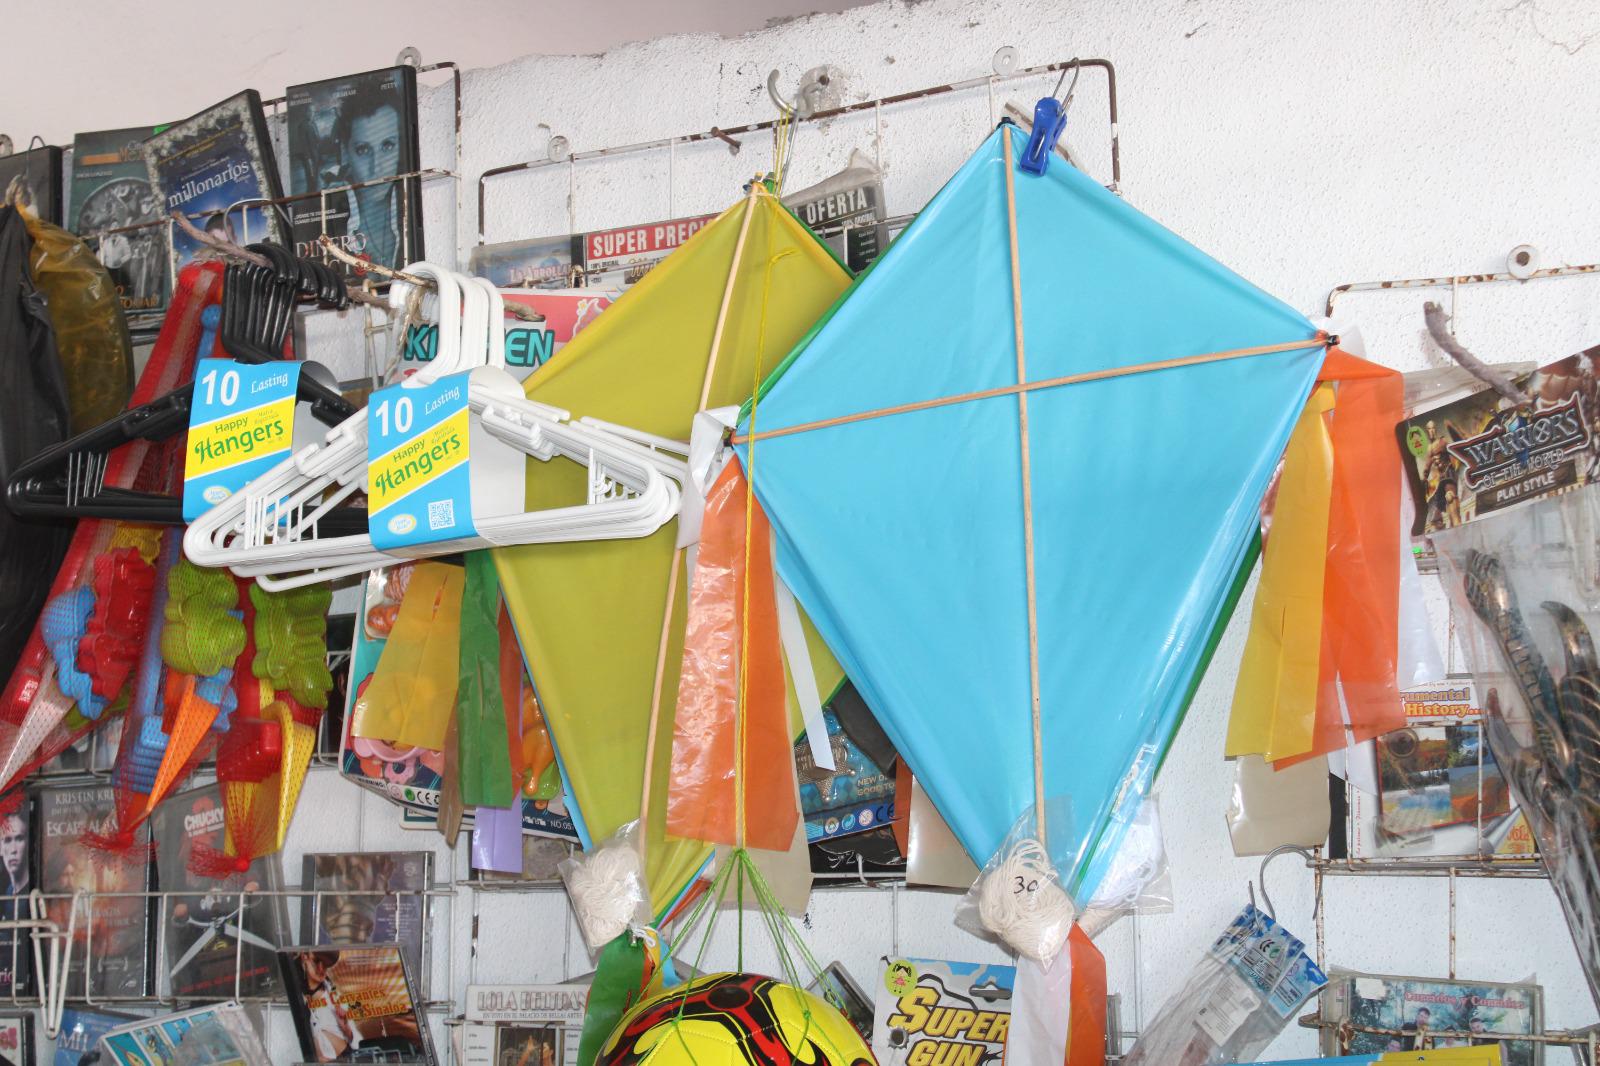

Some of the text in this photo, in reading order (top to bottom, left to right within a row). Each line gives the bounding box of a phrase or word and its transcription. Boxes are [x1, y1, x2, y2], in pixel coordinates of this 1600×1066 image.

[167, 160, 251, 208] millonarios
[806, 187, 868, 225] OFERTA
[593, 217, 711, 257] SUPER PREC
[404, 323, 555, 368] KIEN
[202, 370, 289, 406] 10 Lasting
[215, 416, 249, 434] Happy
[375, 396, 414, 437] 10
[425, 386, 460, 416] Lasting
[194, 419, 284, 465] Hangers
[393, 438, 426, 463] Happy
[1464, 408, 1580, 466] WARRIORS
[375, 433, 461, 497] Hangers
[1496, 471, 1555, 502] PLAY STYLE
[55, 791, 95, 805] KRISTIN
[857, 774, 877, 787] NEW
[857, 784, 882, 796] GOOD
[184, 807, 224, 831] CHUCKY
[477, 991, 518, 1011] LOLA
[886, 985, 1011, 1044] SUPER
[905, 1038, 988, 1066] GUN
